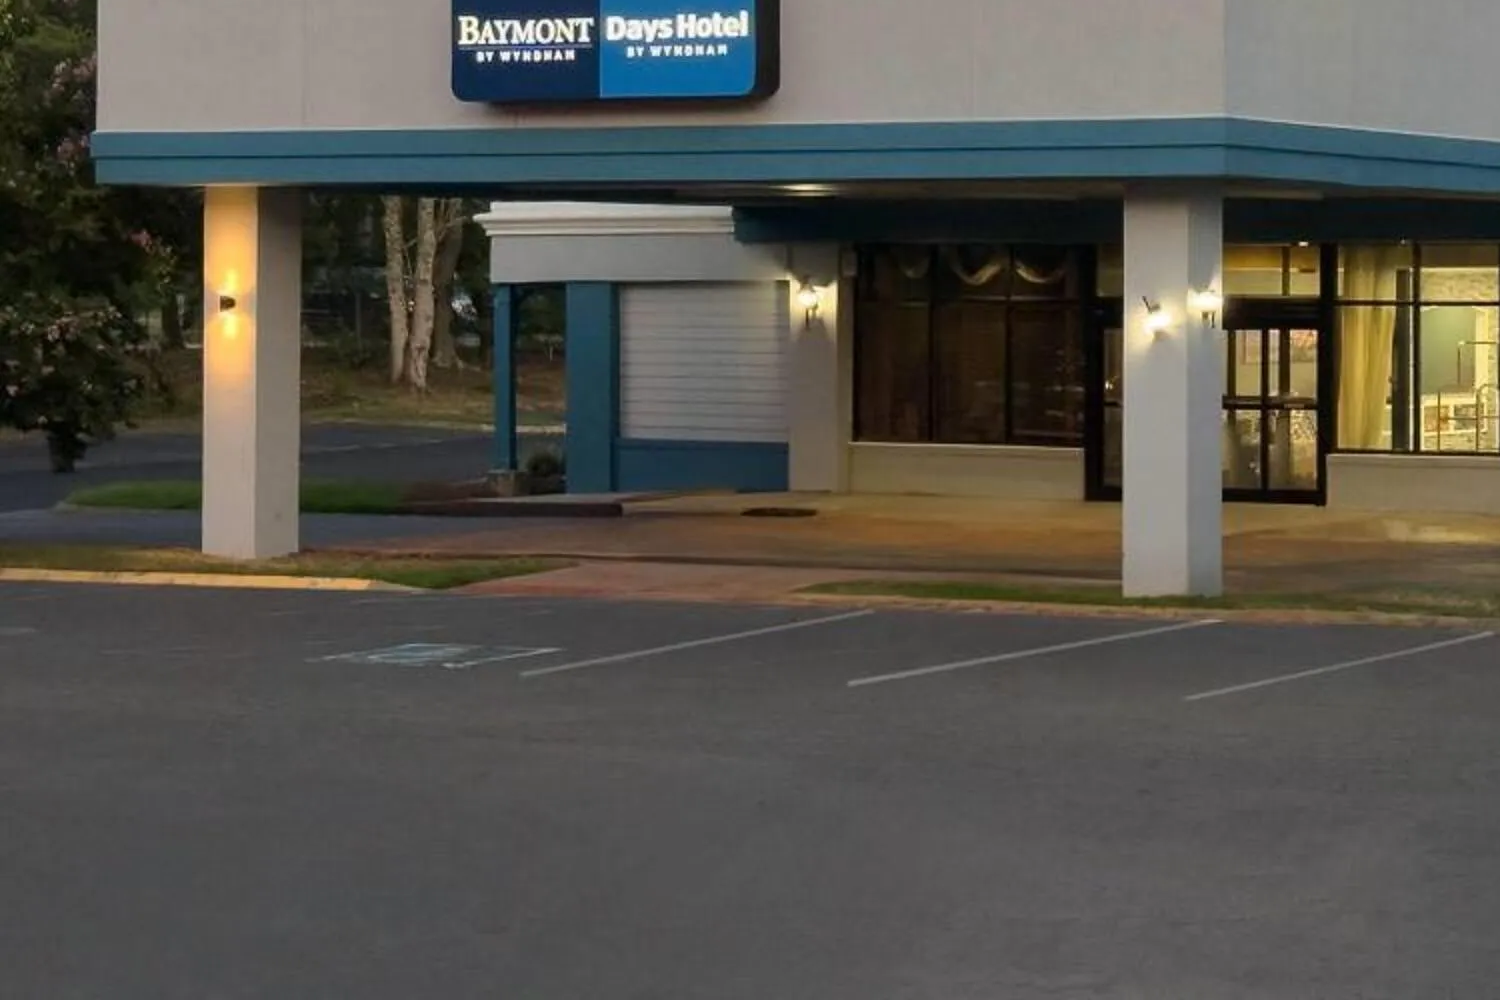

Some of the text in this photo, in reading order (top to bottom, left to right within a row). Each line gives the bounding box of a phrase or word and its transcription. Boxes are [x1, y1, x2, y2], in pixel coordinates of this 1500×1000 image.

[457, 15, 594, 45] BAYMONT
[605, 9, 749, 43] Days Hotel
[476, 49, 576, 62] BY WYNDHAM
[626, 44, 728, 58] BY WYNDHAM
